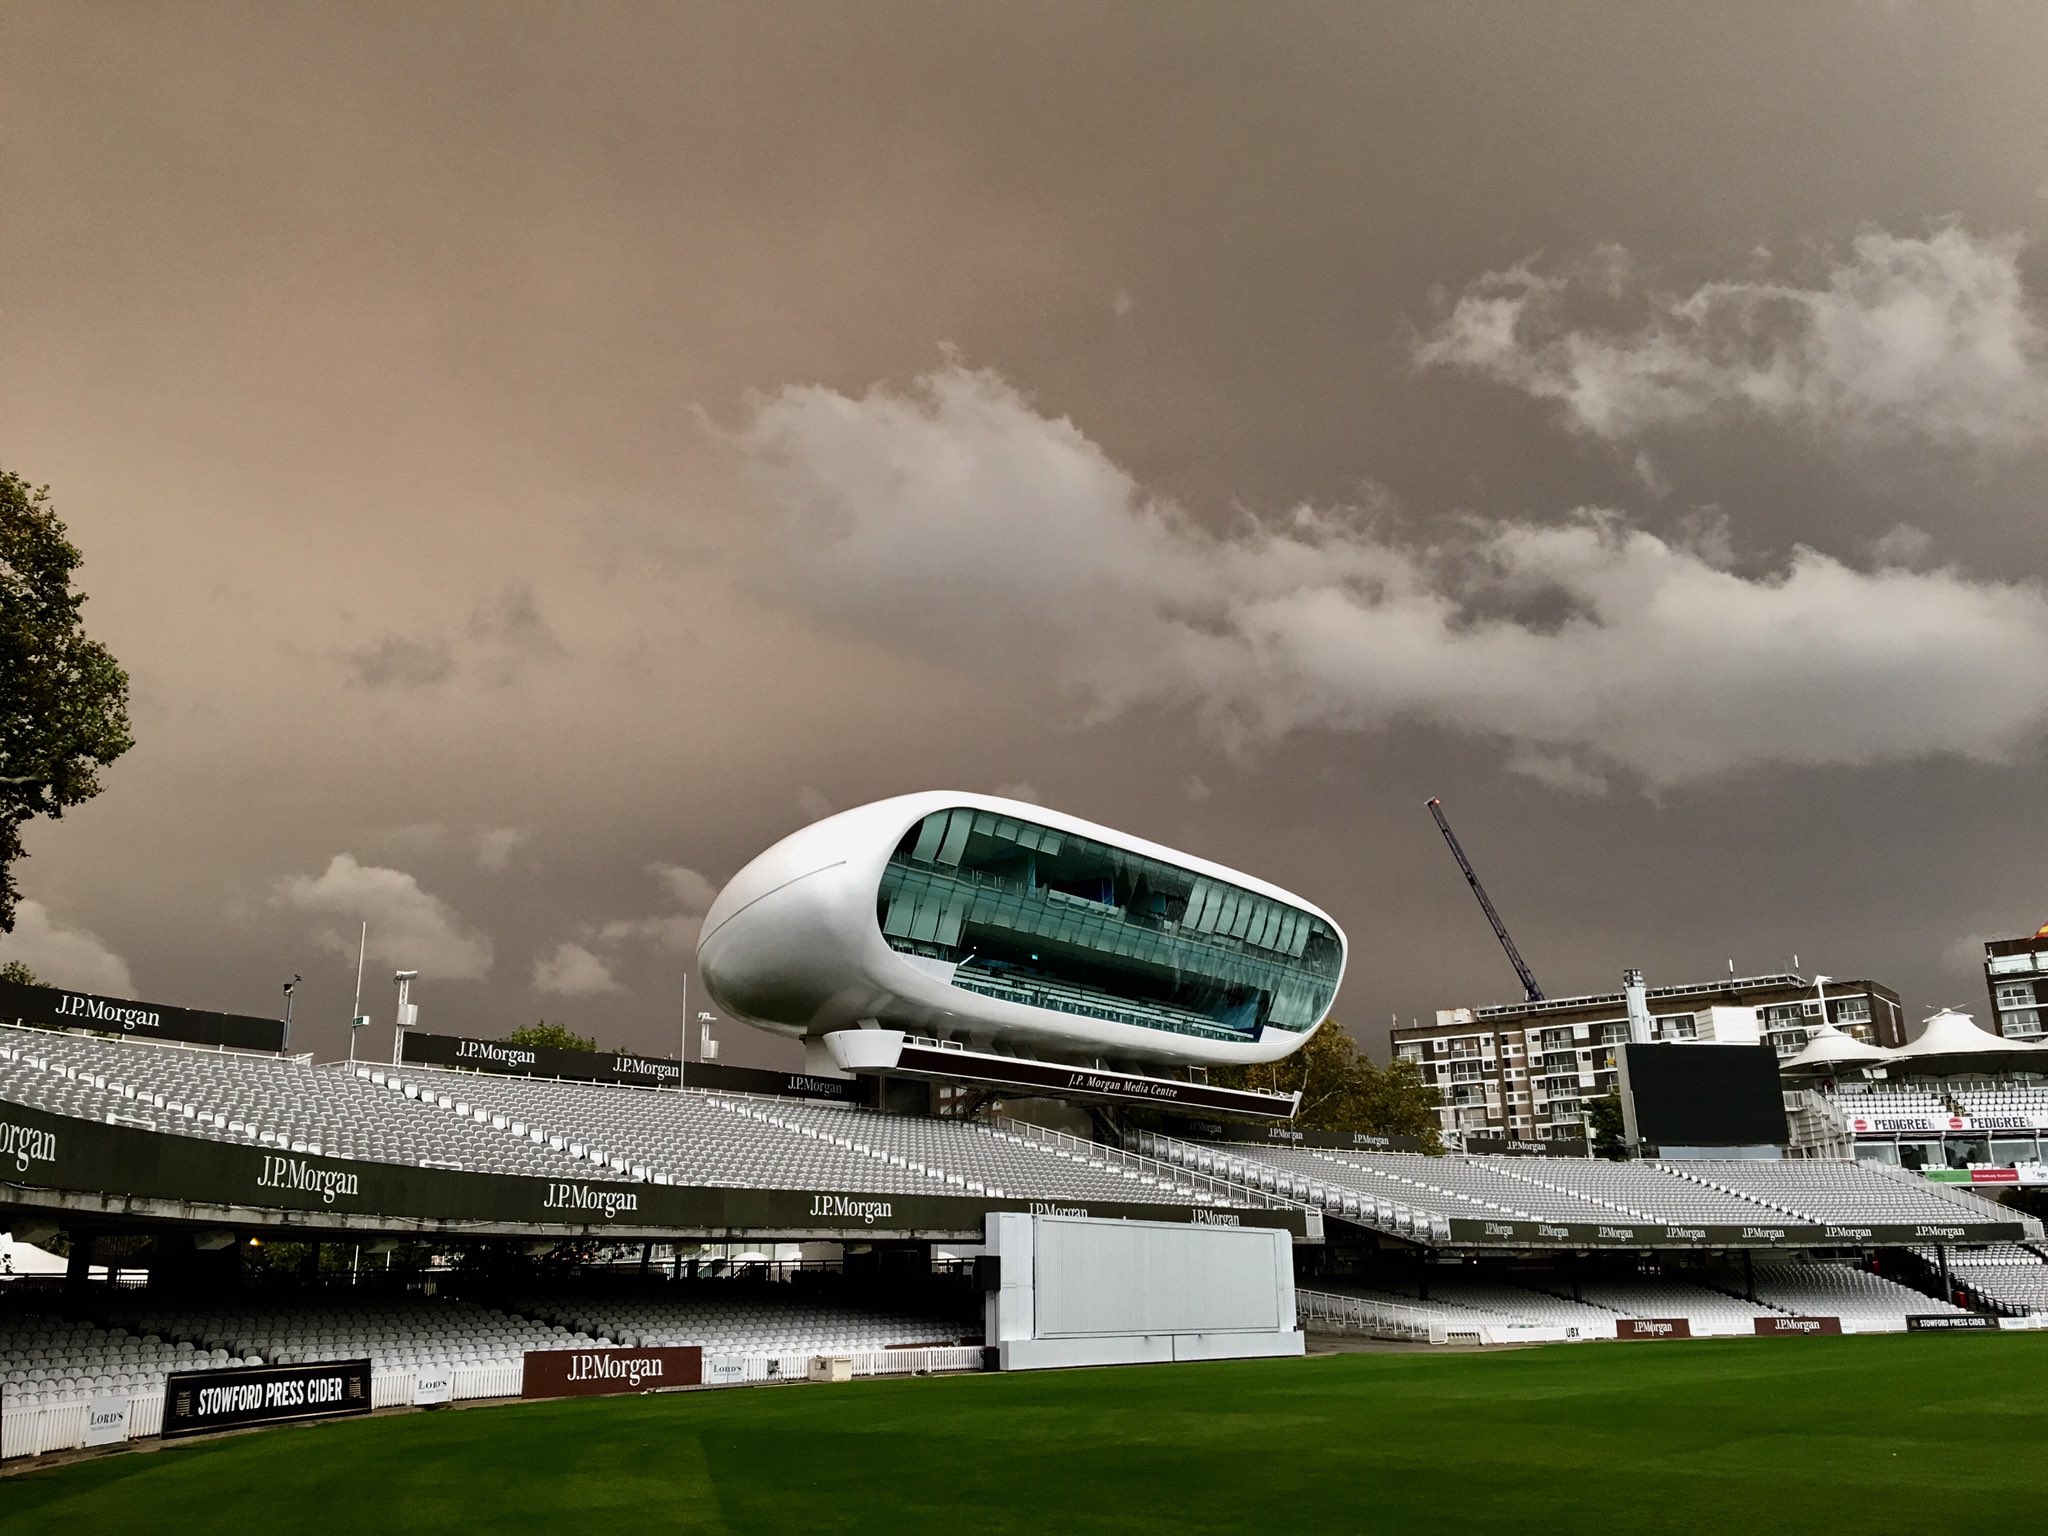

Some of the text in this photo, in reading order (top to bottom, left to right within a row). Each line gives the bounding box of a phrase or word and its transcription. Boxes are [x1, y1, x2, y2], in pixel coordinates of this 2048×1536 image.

[55, 995, 160, 1030] J.P.Morgan
[456, 1041, 535, 1066] J.P.Morgan
[612, 1057, 680, 1080] J.P.Morgan
[787, 1076, 842, 1097] J.P.Morgan
[1068, 1074, 1178, 1097] J.P. Morgan Media Centre
[1874, 1118, 1929, 1130] PEDIGREE
[1969, 1116, 2027, 1129] PEDIGREE
[1268, 1127, 1303, 1141] J.P.Morgan
[1352, 1133, 1390, 1147] J.P.Morgan
[1506, 1141, 1546, 1153] J.P.Morgan
[257, 1155, 359, 1204] J.P.Morgan
[543, 1183, 638, 1219] J.P.Morgan
[809, 1195, 893, 1224] J.P.Morgan
[1029, 1202, 1088, 1218] JPMoran
[1484, 1222, 1513, 1239] J.P.Morgan
[1538, 1224, 1569, 1241] J.P.Morgan
[1597, 1226, 1634, 1242] J.P.Morgan
[1665, 1227, 1706, 1242] J.P.Morgan
[1741, 1227, 1785, 1242] J.P.Morgan
[1824, 1226, 1872, 1240] J.P.Morgan
[1914, 1225, 1966, 1239] J.P.Morgan
[1774, 1319, 1821, 1332] J.P.Morgan
[1919, 1317, 1986, 1328] STOWFORD PRESS CIDER
[566, 1354, 664, 1387] J.P.Morgan
[198, 1377, 343, 1416] STOWFORD PRESS CIDER
[90, 1412, 124, 1426] LORD'S
